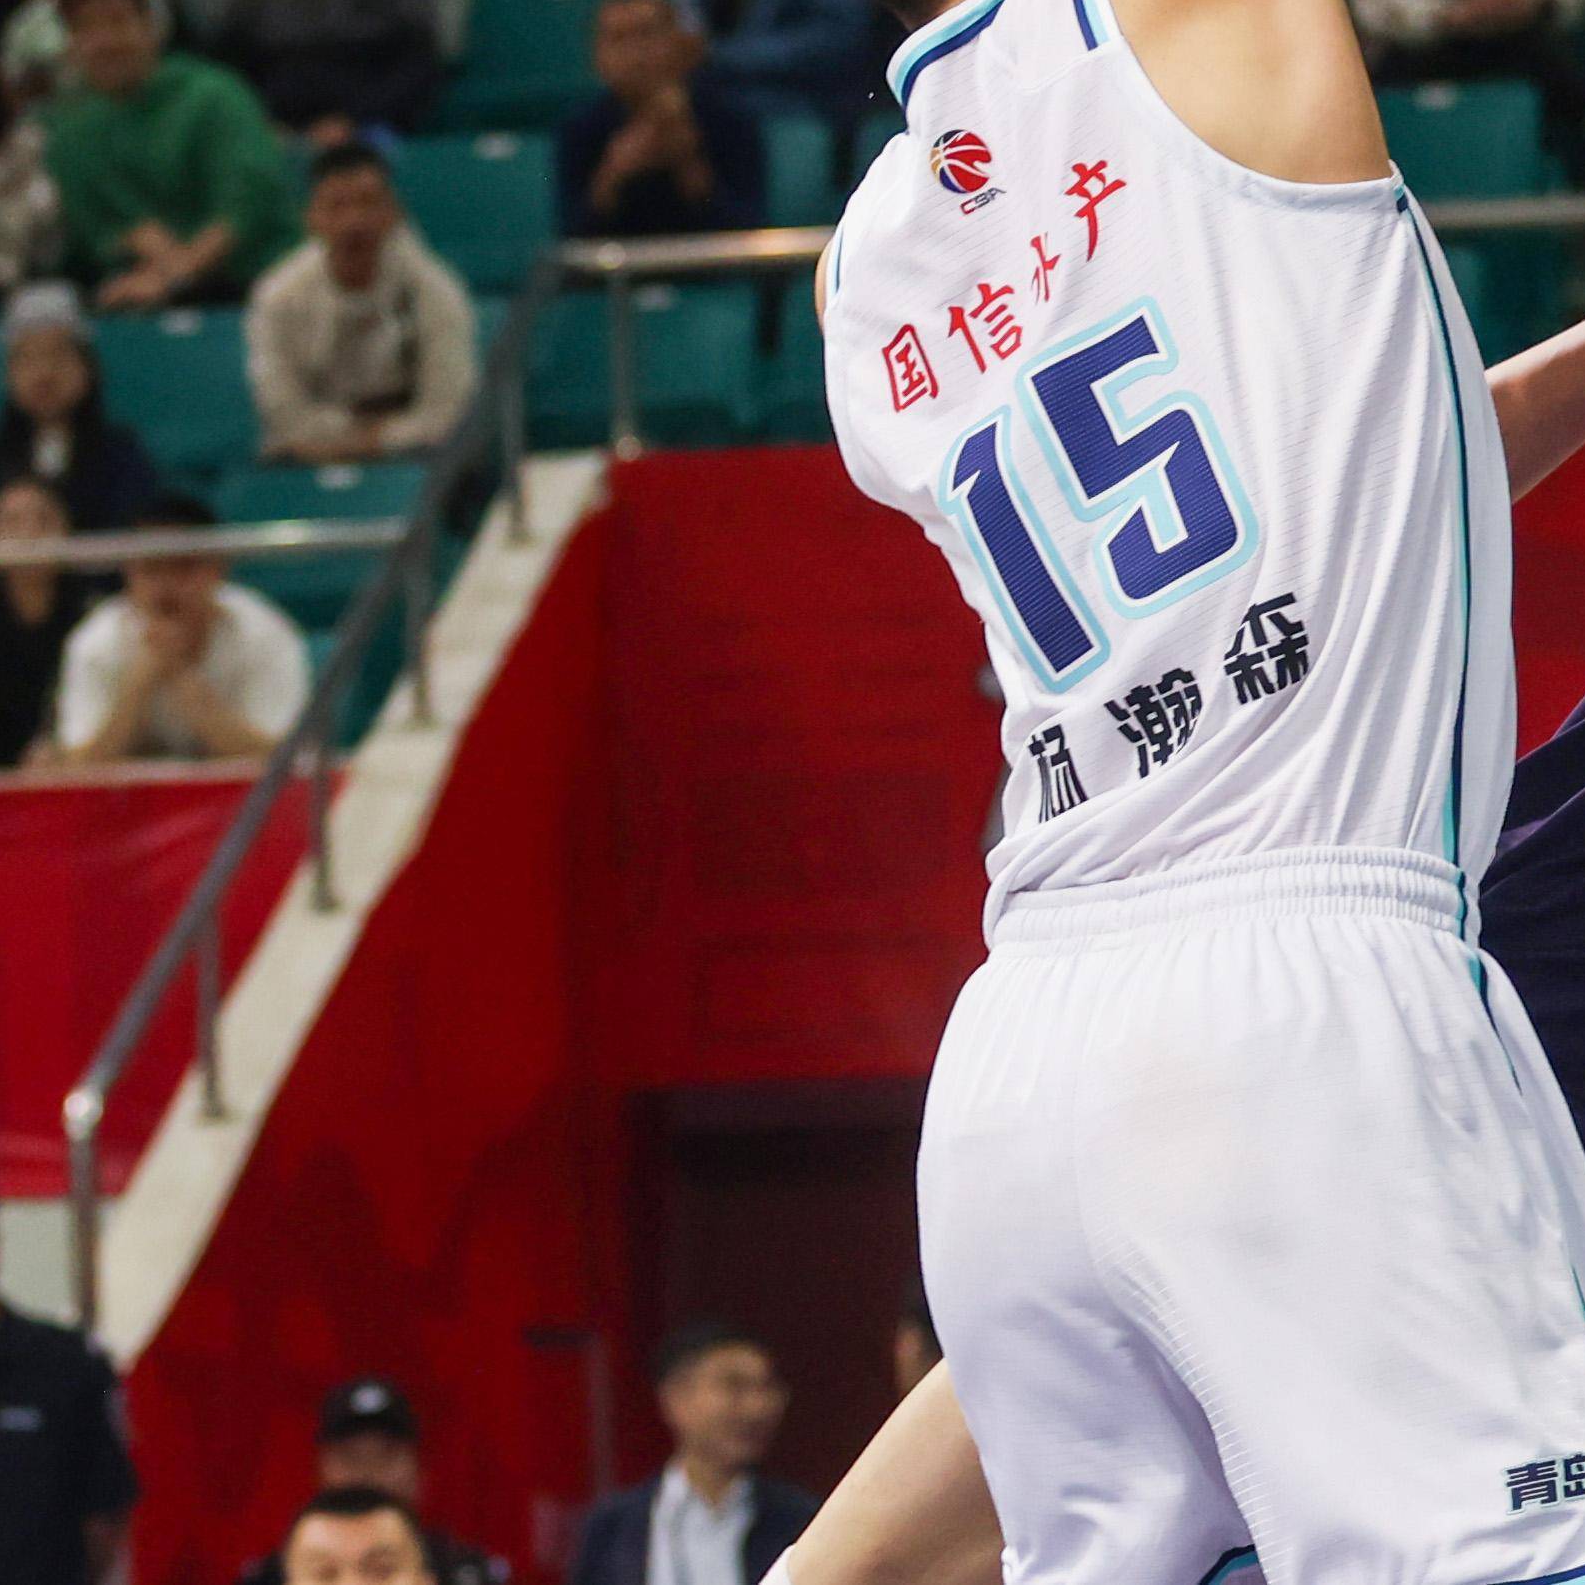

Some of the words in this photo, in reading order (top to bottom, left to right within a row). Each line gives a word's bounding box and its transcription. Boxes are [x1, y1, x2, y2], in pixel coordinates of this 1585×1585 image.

[882, 159, 1128, 414] 国信水产
[960, 187, 1007, 215] CBA
[939, 295, 1260, 695] 15
